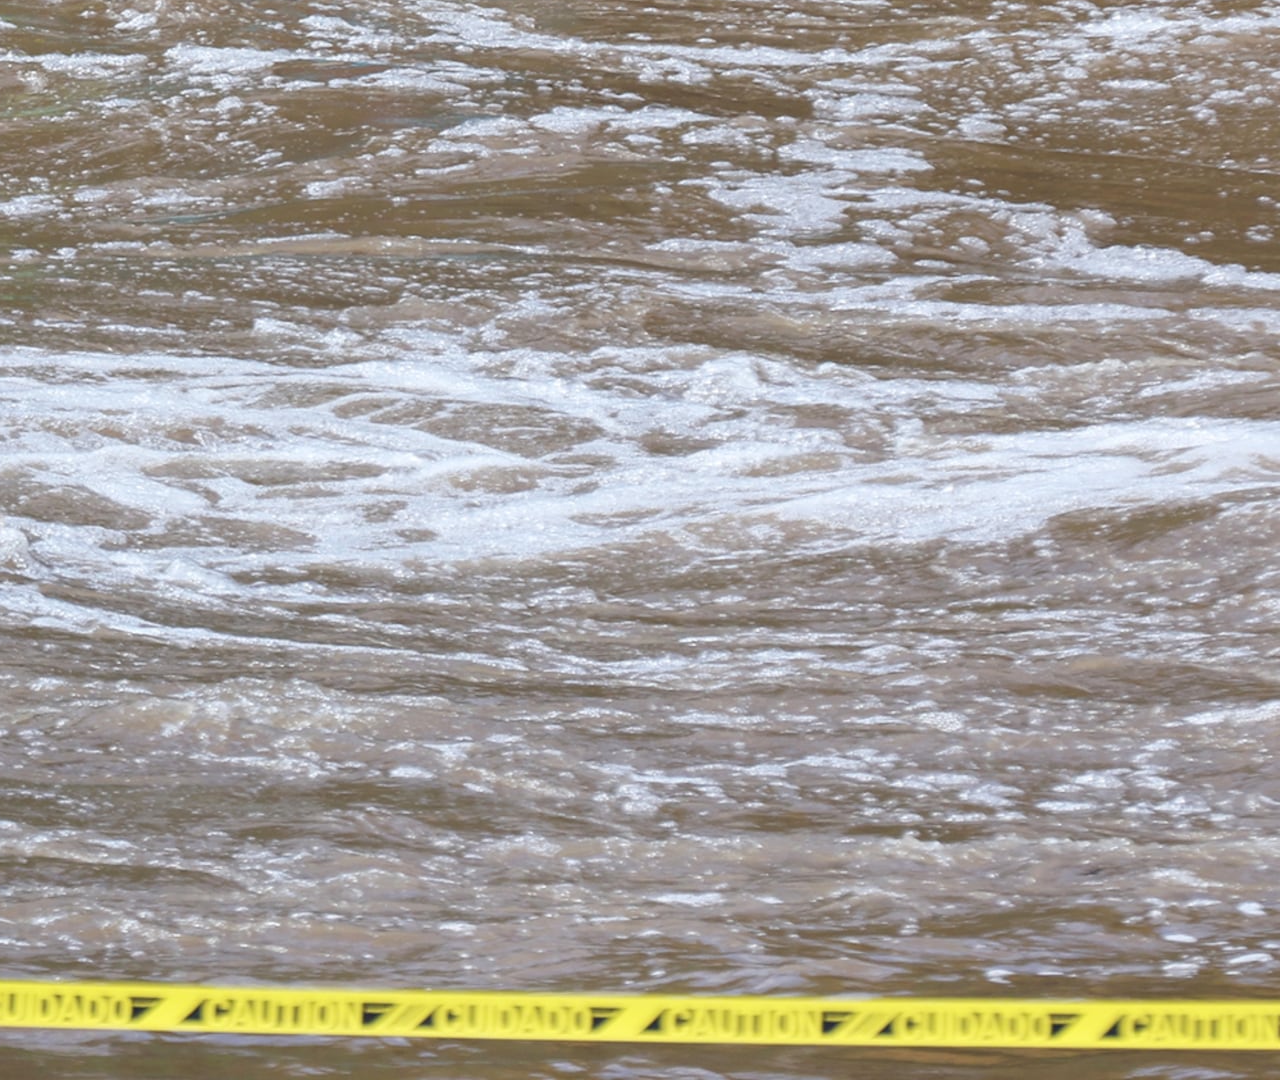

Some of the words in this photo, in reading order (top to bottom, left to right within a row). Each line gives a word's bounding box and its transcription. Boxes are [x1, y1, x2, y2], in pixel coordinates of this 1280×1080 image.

[202, 999, 363, 1030] CAUTION
[434, 1005, 592, 1034] CUIDADO
[660, 1009, 823, 1040] CAUTION
[892, 1012, 1052, 1041] CUIDADO
